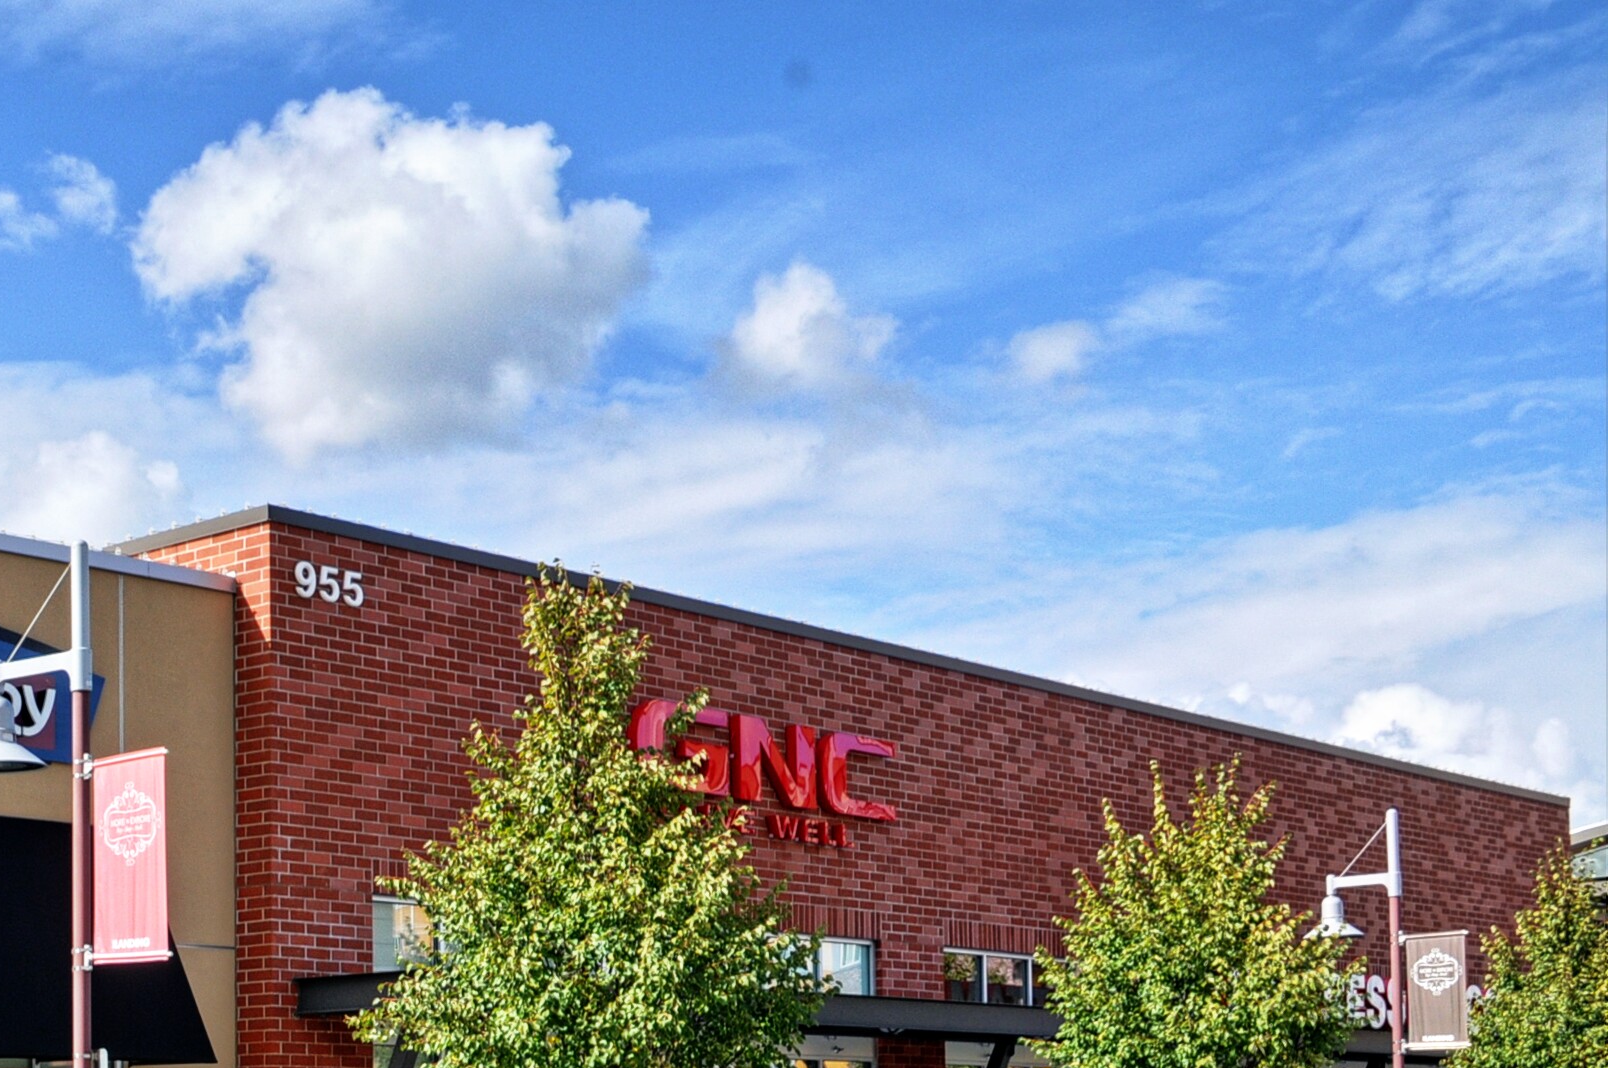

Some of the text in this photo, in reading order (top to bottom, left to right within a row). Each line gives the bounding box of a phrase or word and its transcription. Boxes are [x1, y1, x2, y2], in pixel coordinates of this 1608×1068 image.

[294, 560, 364, 607] 955
[627, 699, 896, 821] GNC
[765, 815, 855, 848] WELL
